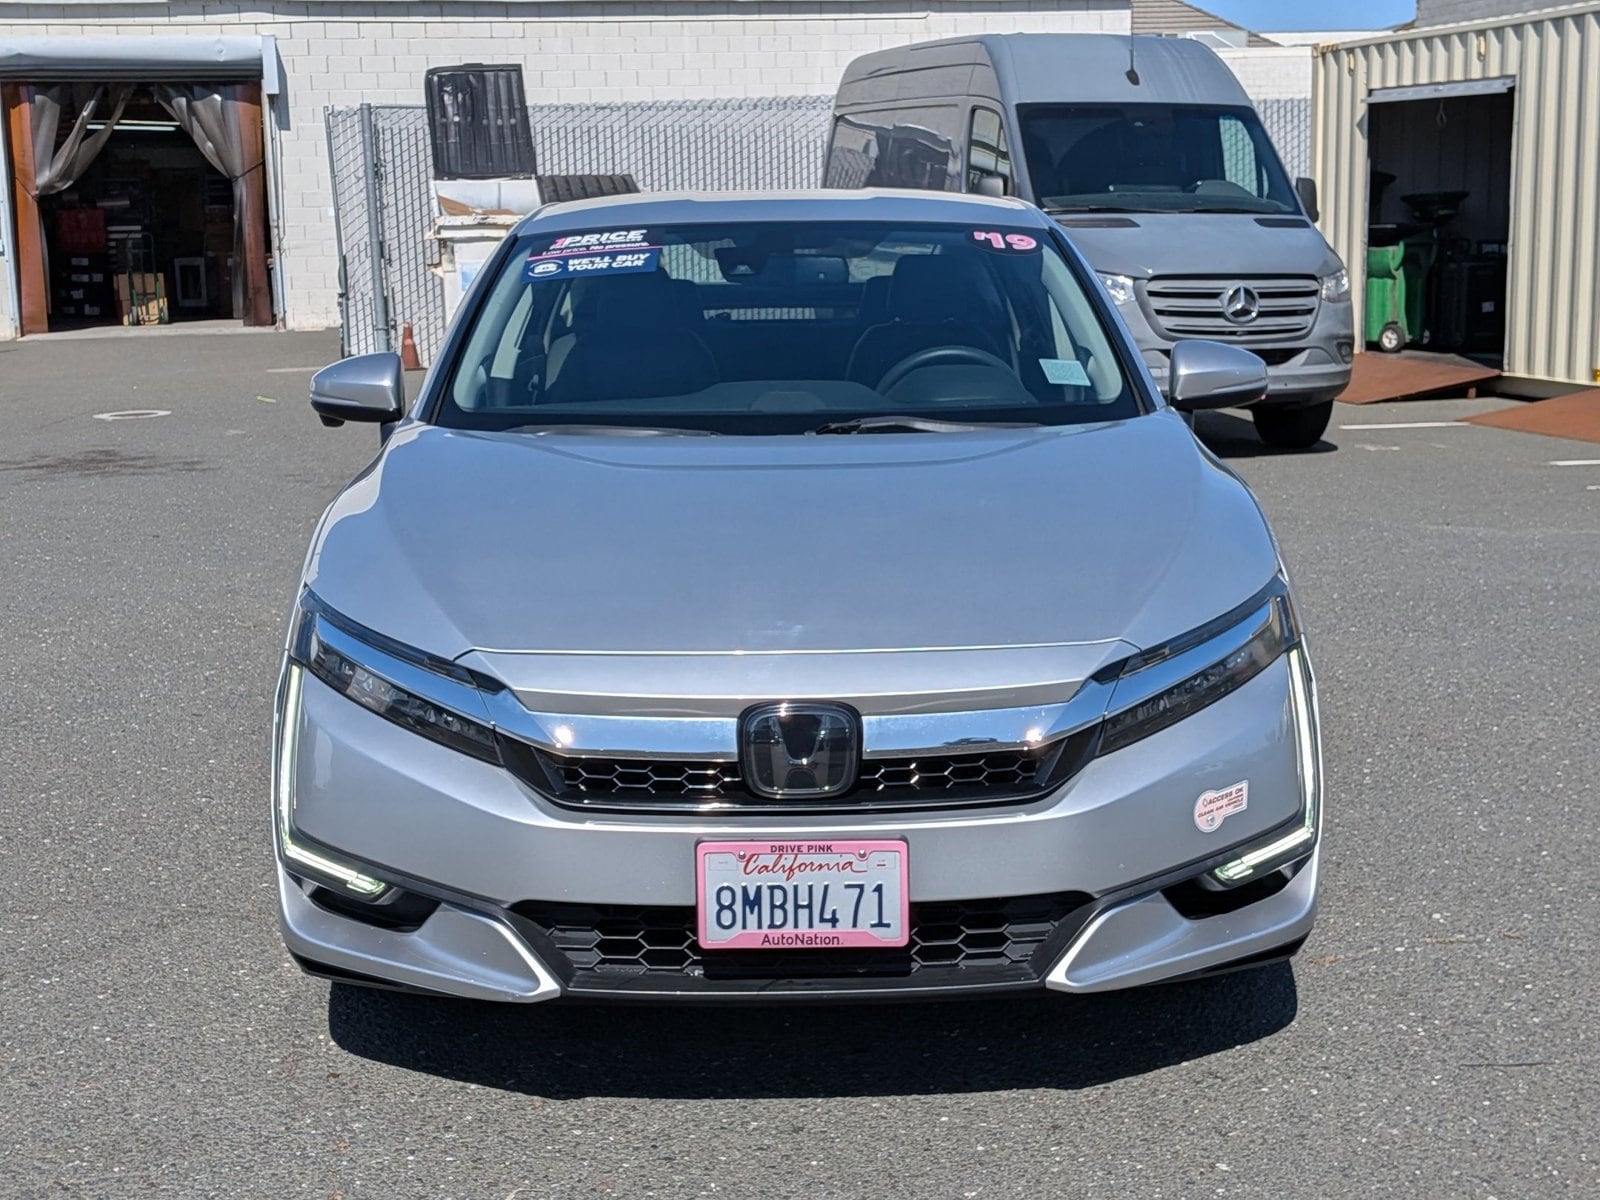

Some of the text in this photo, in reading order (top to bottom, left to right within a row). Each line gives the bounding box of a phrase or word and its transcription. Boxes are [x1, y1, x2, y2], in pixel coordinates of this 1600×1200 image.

[615, 253, 650, 262] BUY
[568, 259, 645, 271] YOUR CAR
[1208, 791, 1233, 805] ACCESS
[1234, 787, 1244, 795] OK
[1197, 808, 1215, 818] CLEAN
[770, 845, 833, 853] DRIVE PINK
[743, 853, 868, 881] California
[715, 882, 891, 930] 8MBH471
